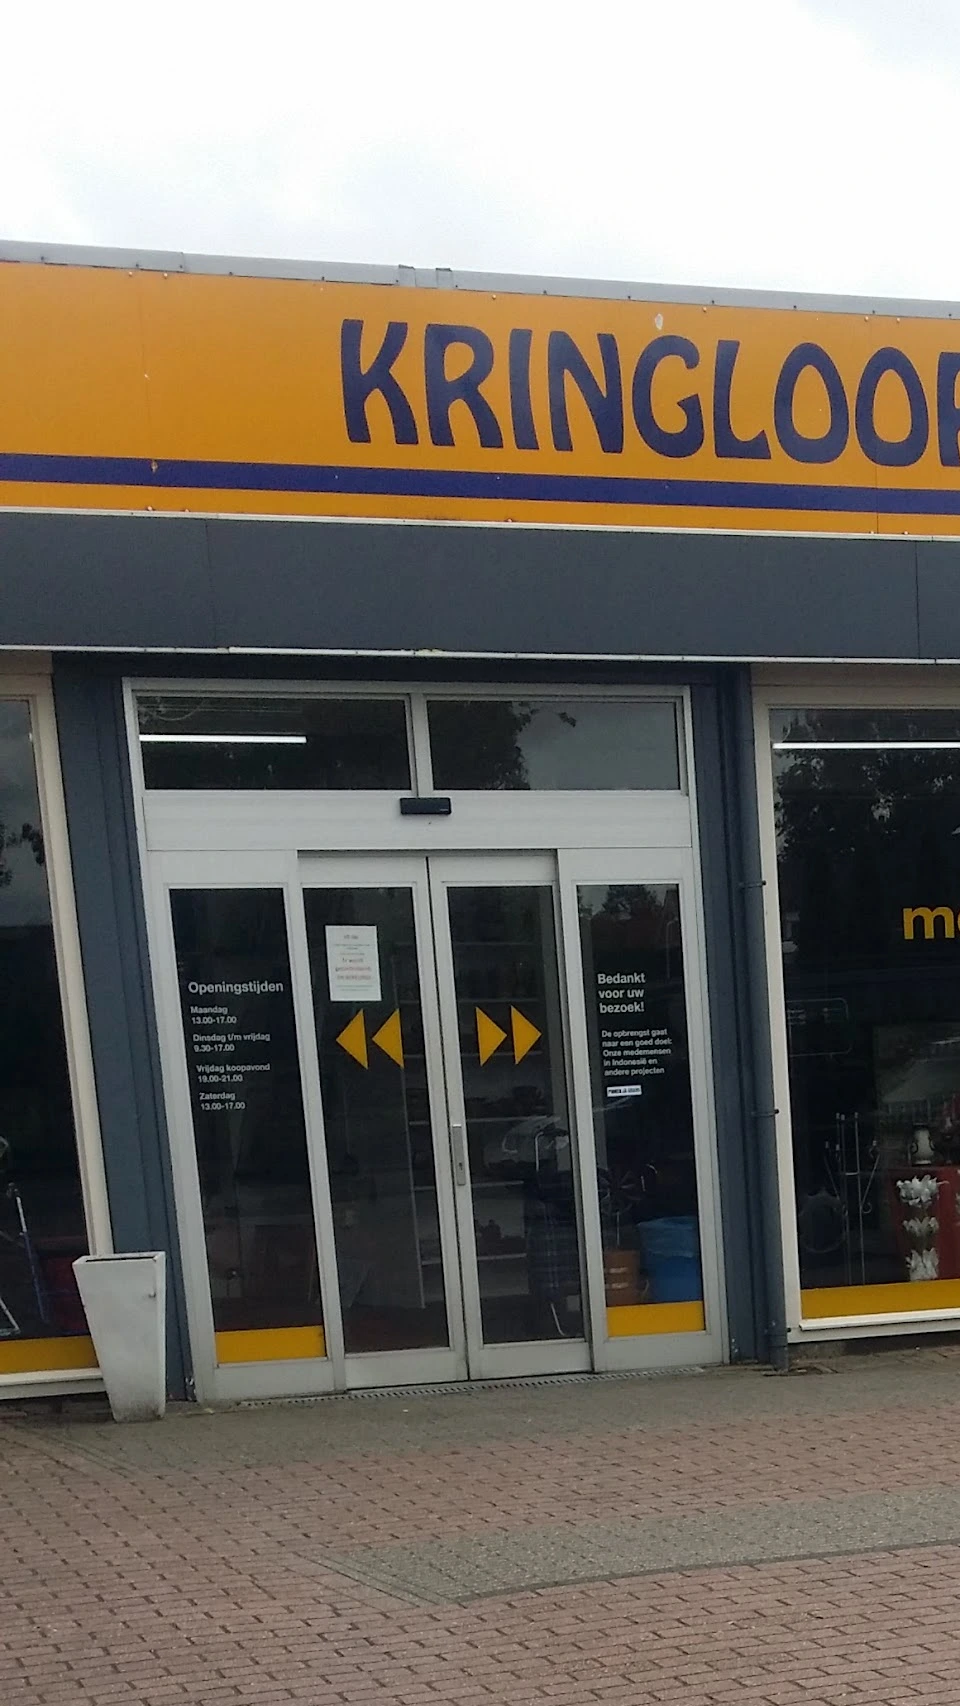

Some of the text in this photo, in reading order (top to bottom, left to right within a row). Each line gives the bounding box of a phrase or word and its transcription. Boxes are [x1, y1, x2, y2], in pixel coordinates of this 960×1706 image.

[597, 972, 646, 984] Bedankt
[188, 981, 284, 995] Openingstijden
[598, 988, 645, 999] voor uw
[190, 1006, 229, 1015] Maandag
[600, 1002, 645, 1014] bezoek!
[191, 1016, 238, 1025] 13.00-17.00
[192, 1032, 271, 1043] Dinsdag t/m vrijdag
[601, 1028, 668, 1039] De opbrengst gaat
[634, 1038, 654, 1048] goed
[193, 1044, 236, 1053] 9.30-17.00
[602, 1050, 622, 1058] Onze
[195, 1063, 271, 1074] Vrijdag koopavond
[604, 1069, 630, 1077] andere
[199, 1092, 237, 1102] Zaterdag
[200, 1102, 247, 1111] 13.00-17.00
